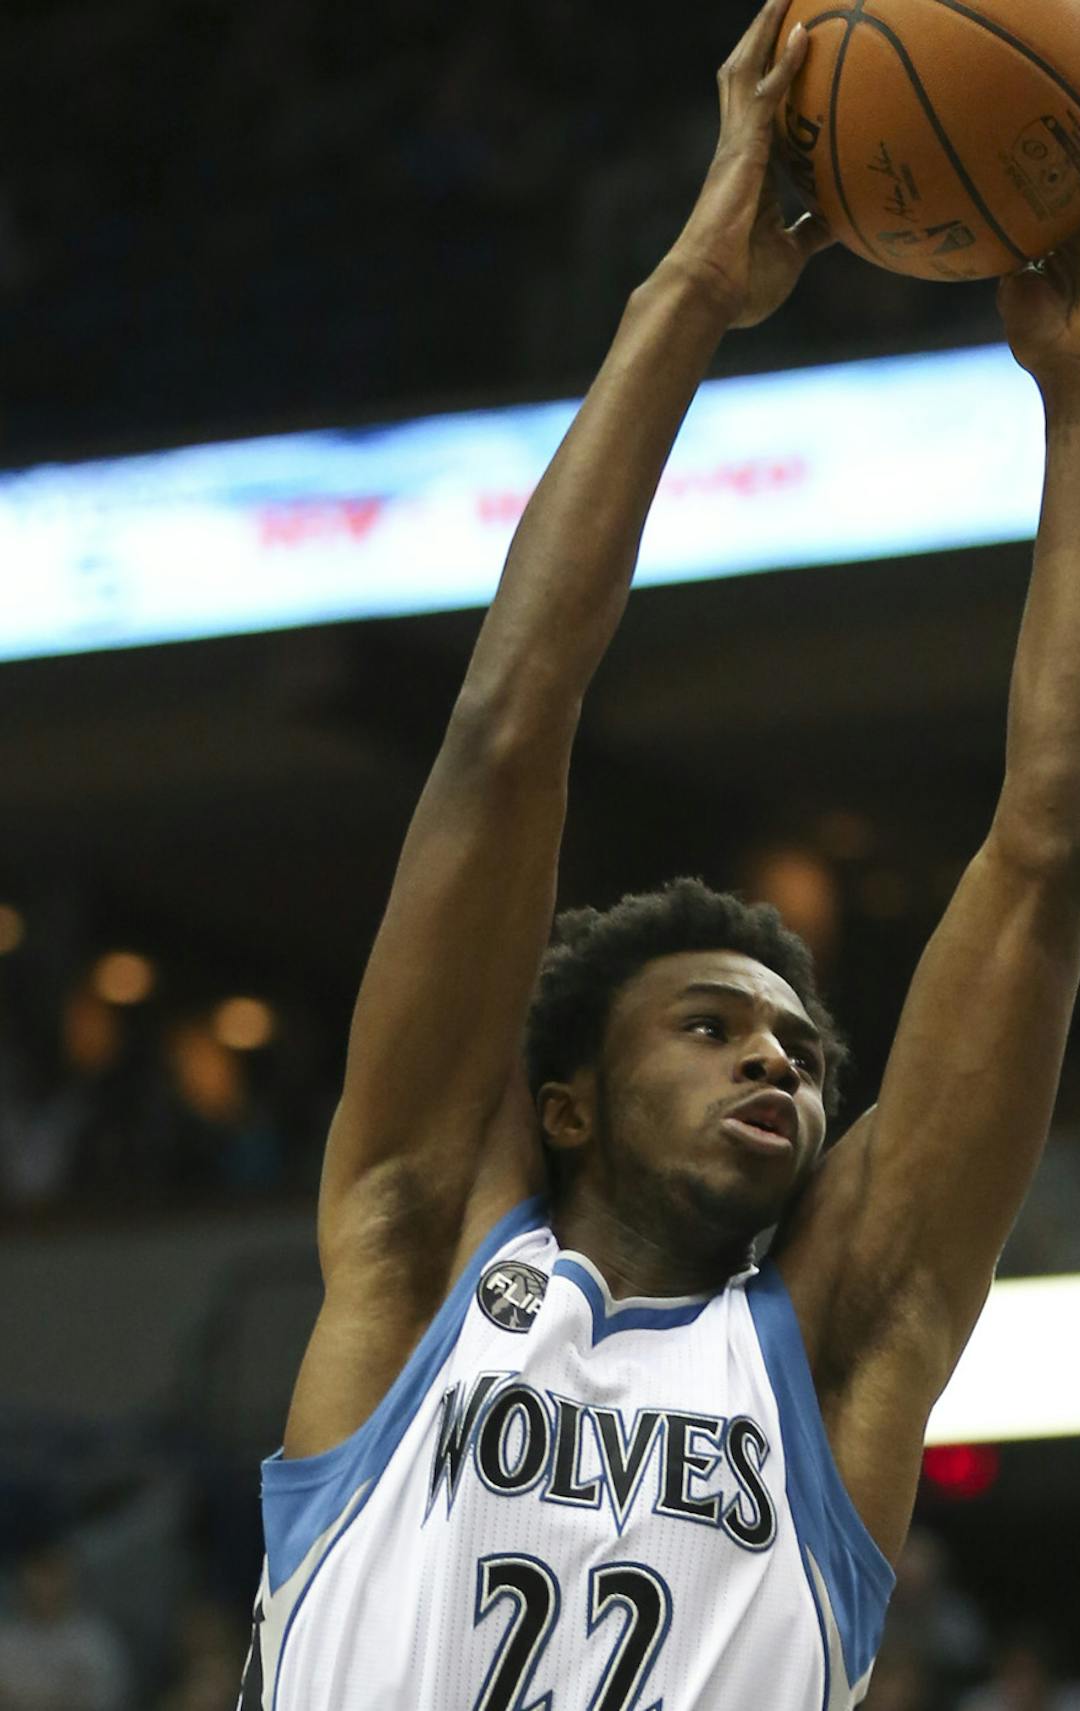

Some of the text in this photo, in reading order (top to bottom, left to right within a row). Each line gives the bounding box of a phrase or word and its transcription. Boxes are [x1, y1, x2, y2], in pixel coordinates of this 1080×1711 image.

[486, 1272, 543, 1314] FLIP
[423, 1370, 778, 1552] WOLVES
[473, 1553, 673, 1711] 22
